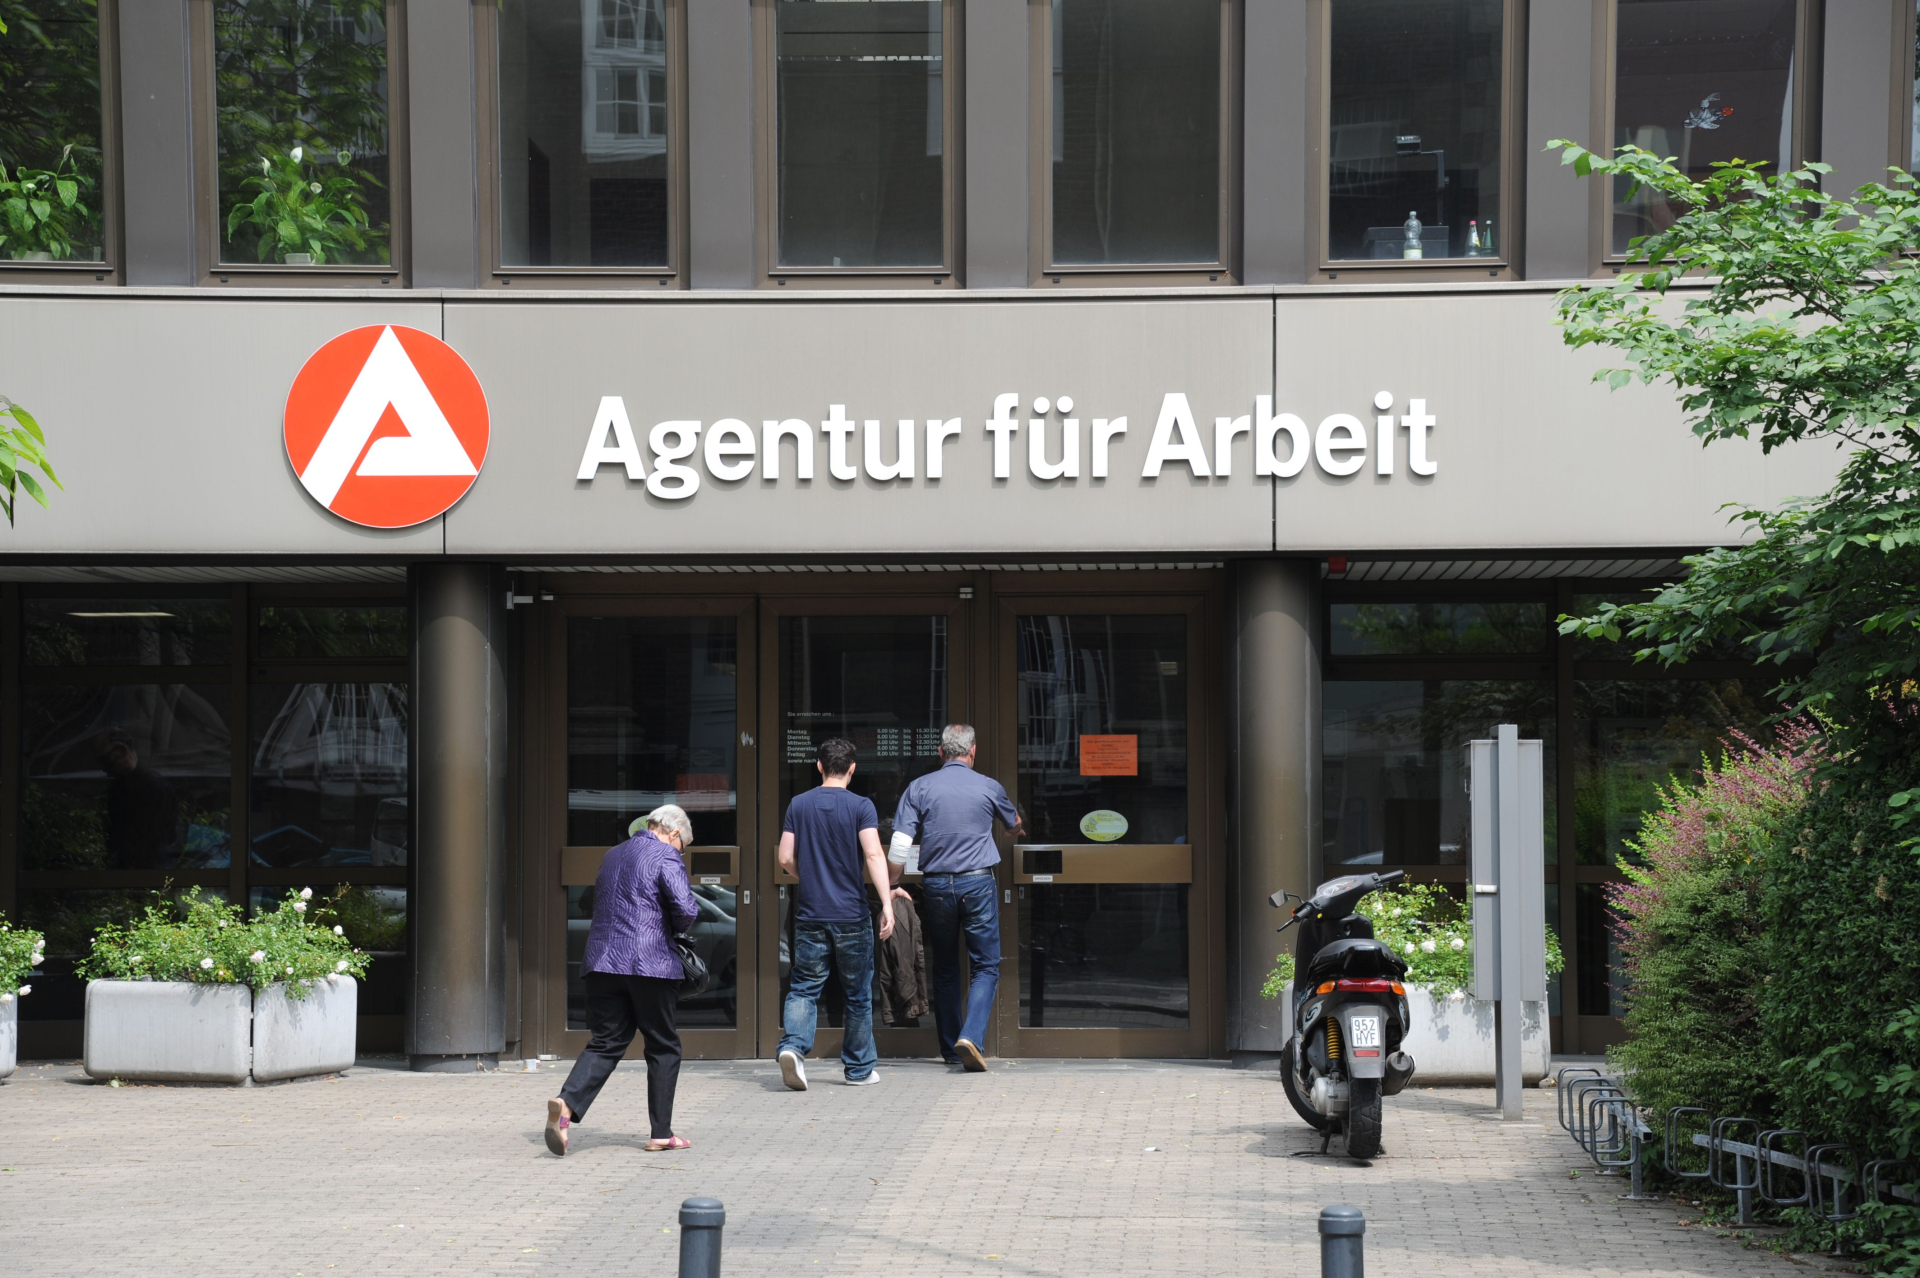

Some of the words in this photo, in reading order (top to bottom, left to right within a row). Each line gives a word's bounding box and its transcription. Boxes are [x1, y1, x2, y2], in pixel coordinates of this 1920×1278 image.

[576, 396, 962, 500] Agentur
[985, 392, 1128, 480] für
[1141, 391, 1438, 478] Arbeit
[1355, 1019, 1376, 1031] 952
[1356, 1032, 1376, 1045] HYF
